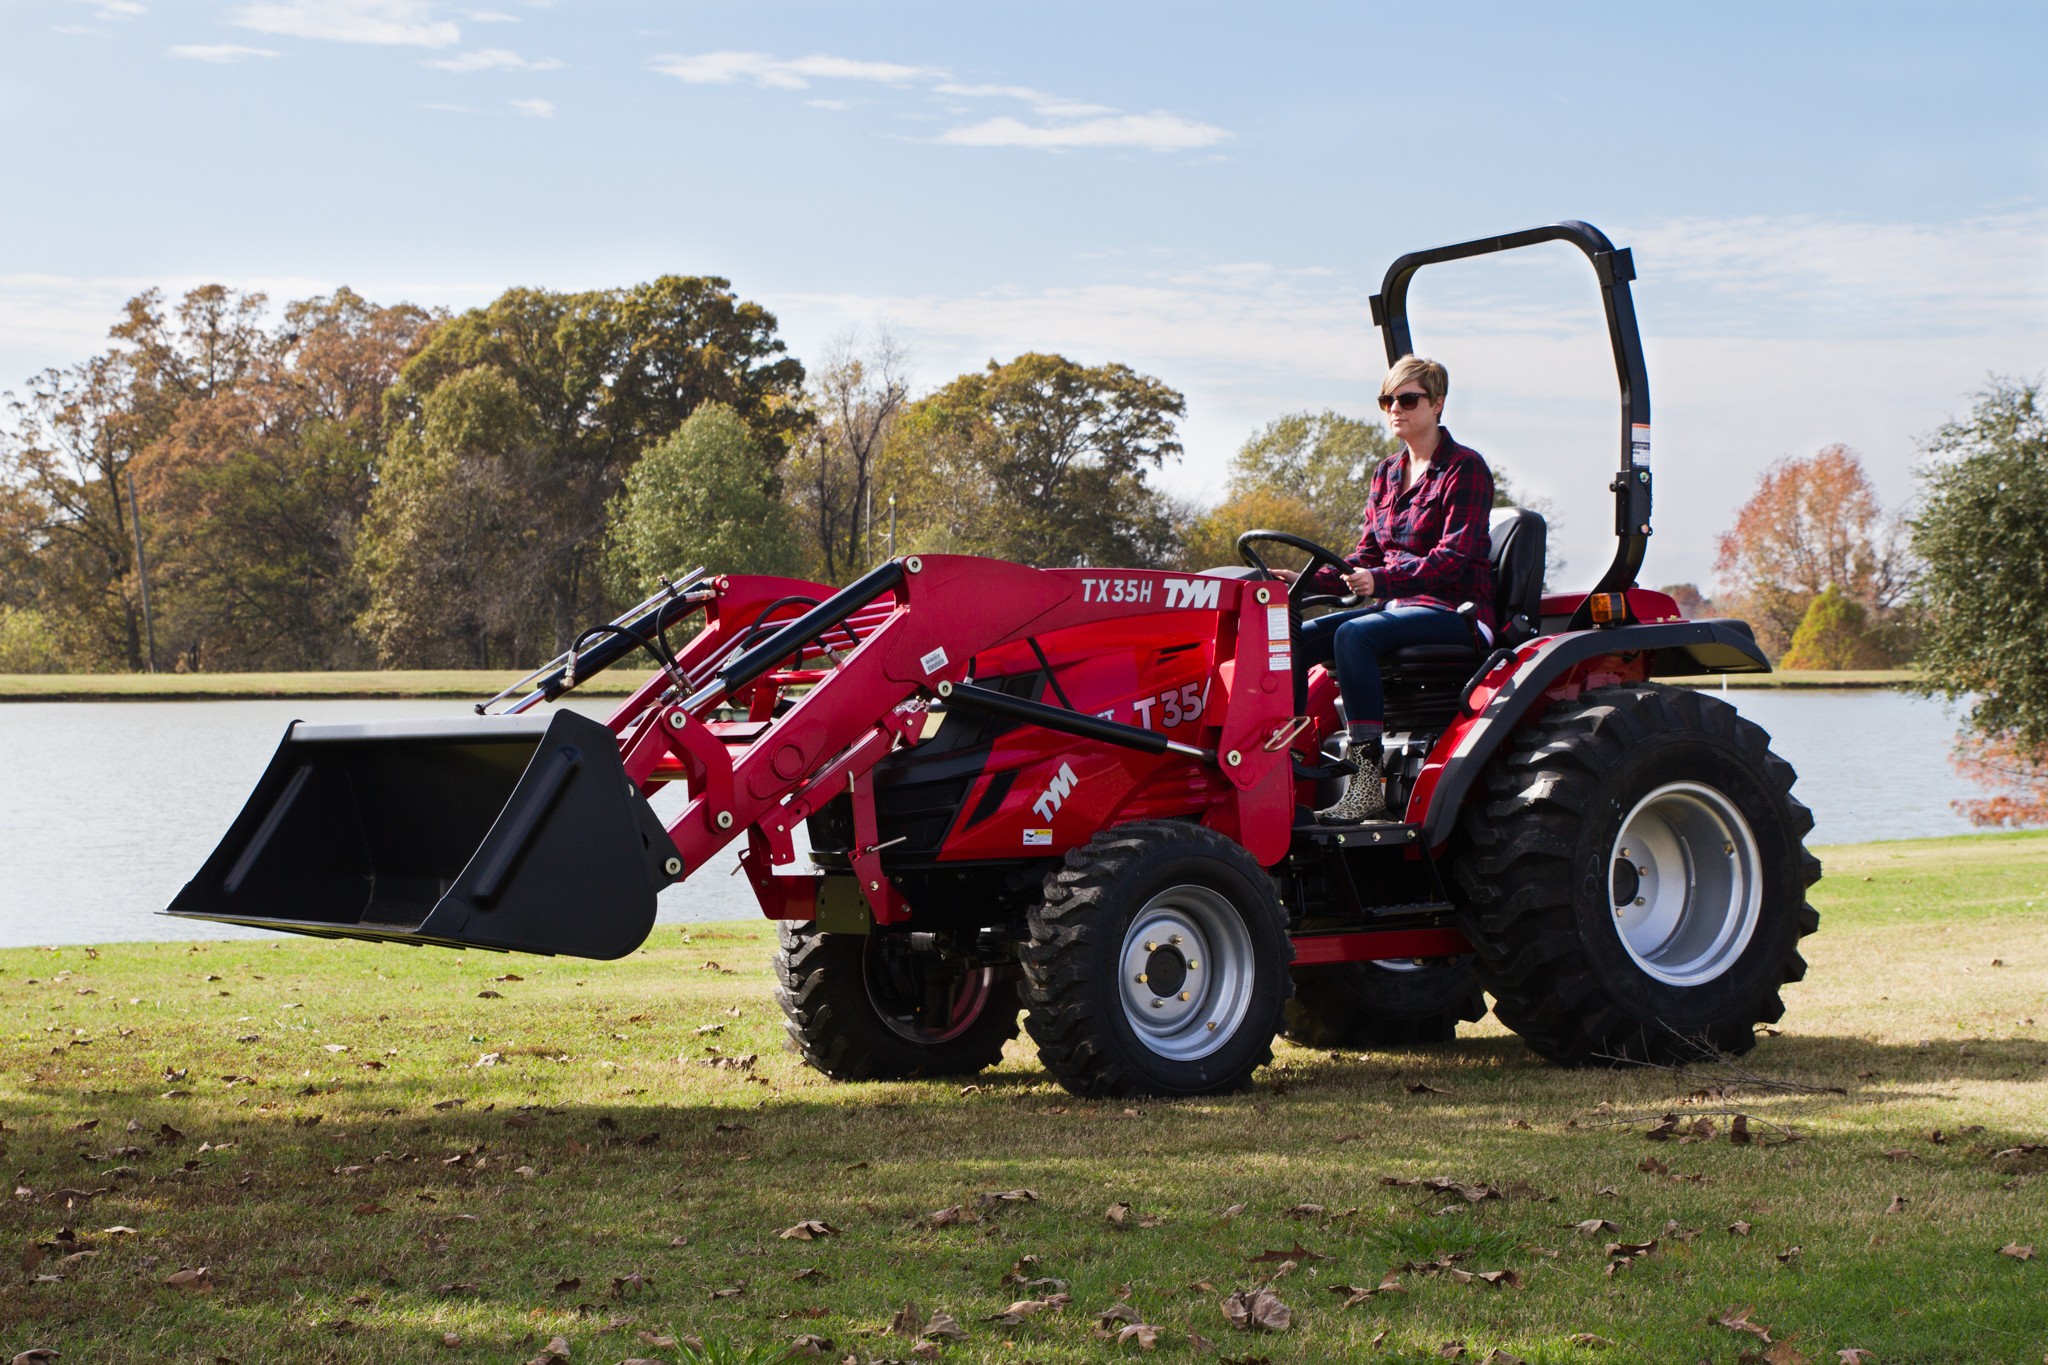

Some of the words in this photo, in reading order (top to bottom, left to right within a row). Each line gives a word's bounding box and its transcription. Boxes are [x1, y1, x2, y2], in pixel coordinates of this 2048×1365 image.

[1081, 579, 1153, 603] TX35H
[1162, 578, 1221, 609] TYM
[1032, 761, 1079, 823] TYM
